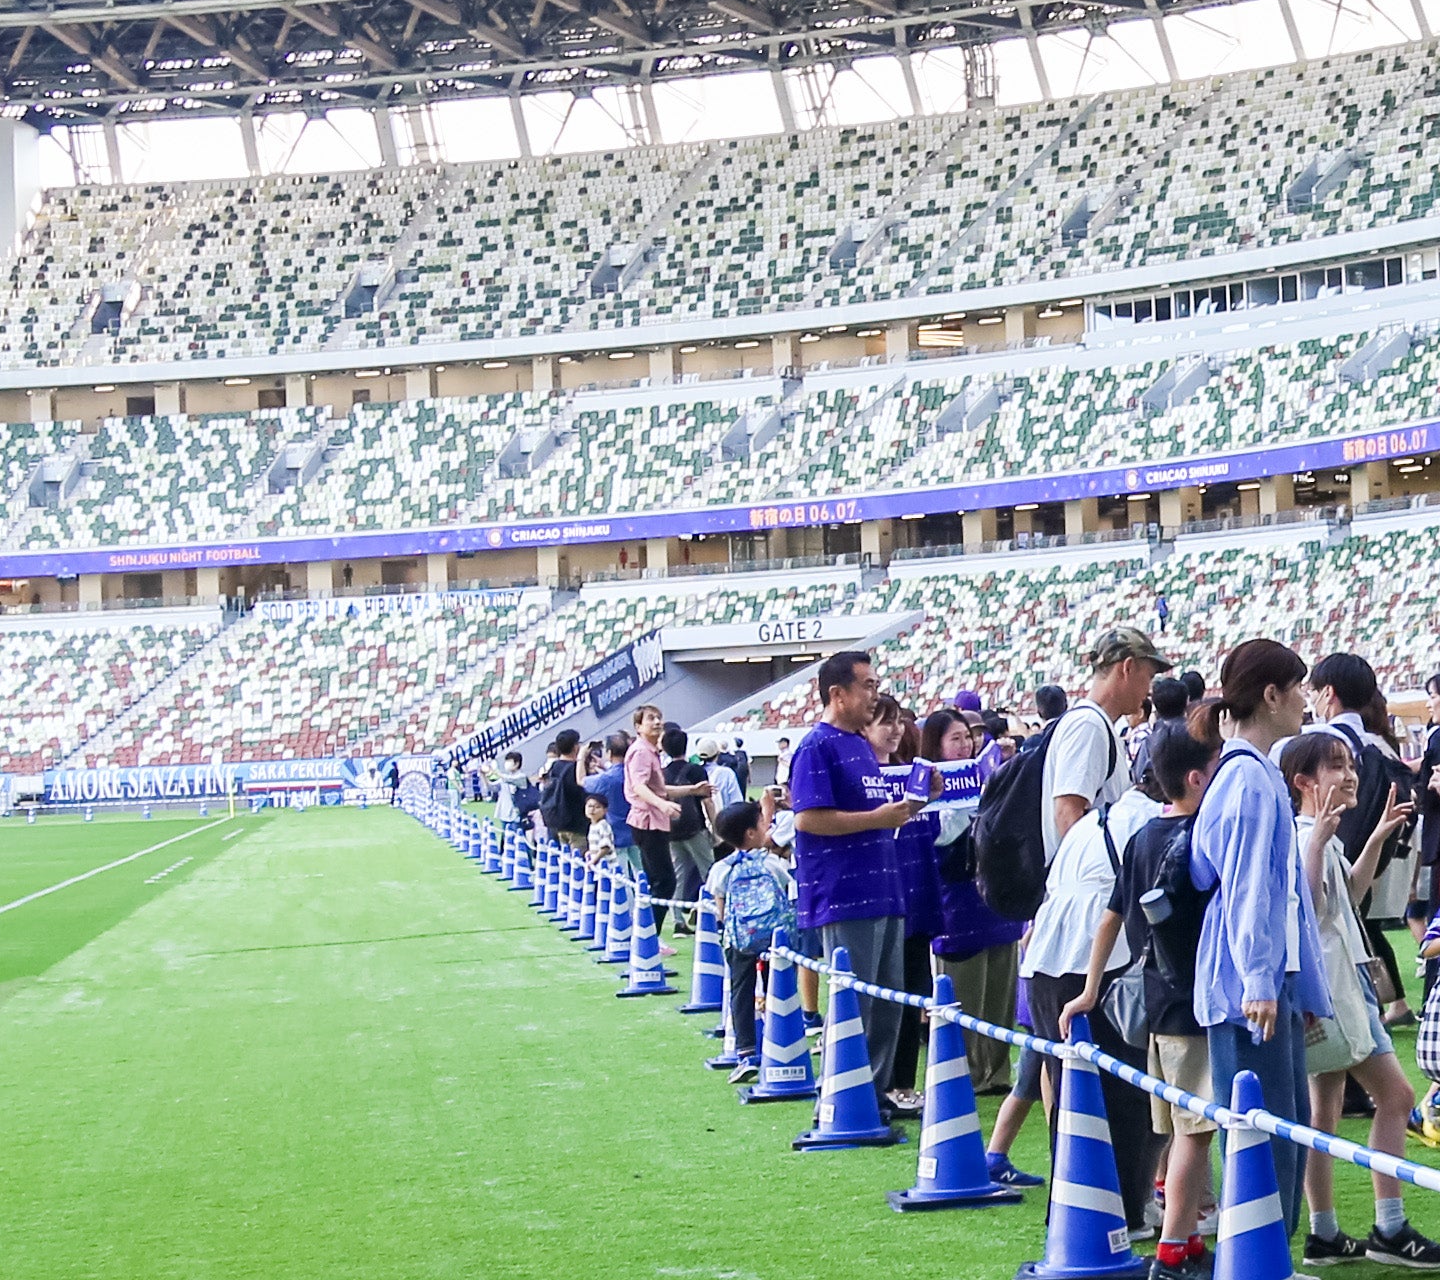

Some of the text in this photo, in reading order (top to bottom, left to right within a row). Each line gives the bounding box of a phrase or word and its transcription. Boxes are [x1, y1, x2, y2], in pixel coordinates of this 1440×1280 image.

[1342, 429, 1428, 461] 新宿の日 06.07
[1146, 463, 1229, 484] CRIACAO SHINJUKU
[750, 501, 856, 528] 新宿の日 06.07
[511, 524, 610, 542] CRIACAO SHINJUKU
[109, 547, 261, 566] SHINJUKU NIGHT FOOTBALL
[758, 619, 823, 643] GATE 2
[531, 685, 566, 730] SOLO
[249, 760, 343, 780] SARA PERCHE
[49, 763, 239, 802] AMORE SENZA FINE
